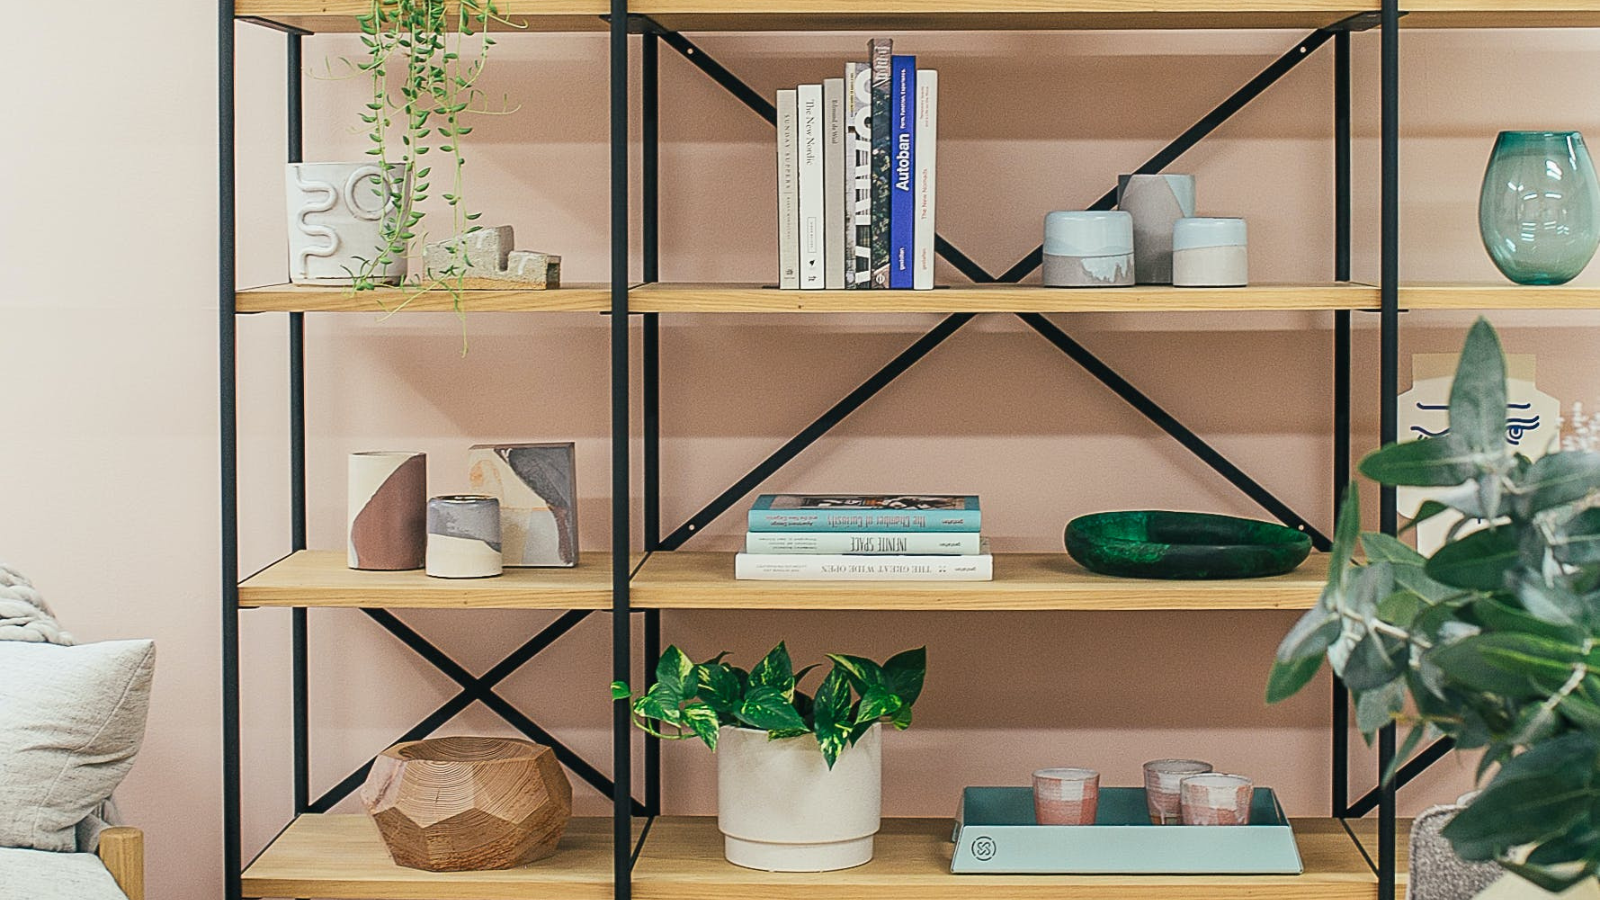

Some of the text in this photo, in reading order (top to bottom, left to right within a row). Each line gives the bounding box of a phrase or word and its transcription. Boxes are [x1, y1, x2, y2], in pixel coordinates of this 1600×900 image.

[805, 99, 815, 166] The New Nordic
[896, 133, 910, 191] Autoban
[827, 514, 864, 528] Curiosity
[865, 515, 874, 528] of
[876, 515, 910, 528] Chamber
[850, 536, 907, 552] INFINITE SPACE
[821, 564, 931, 574] THE GREAT WIDE OPEN
